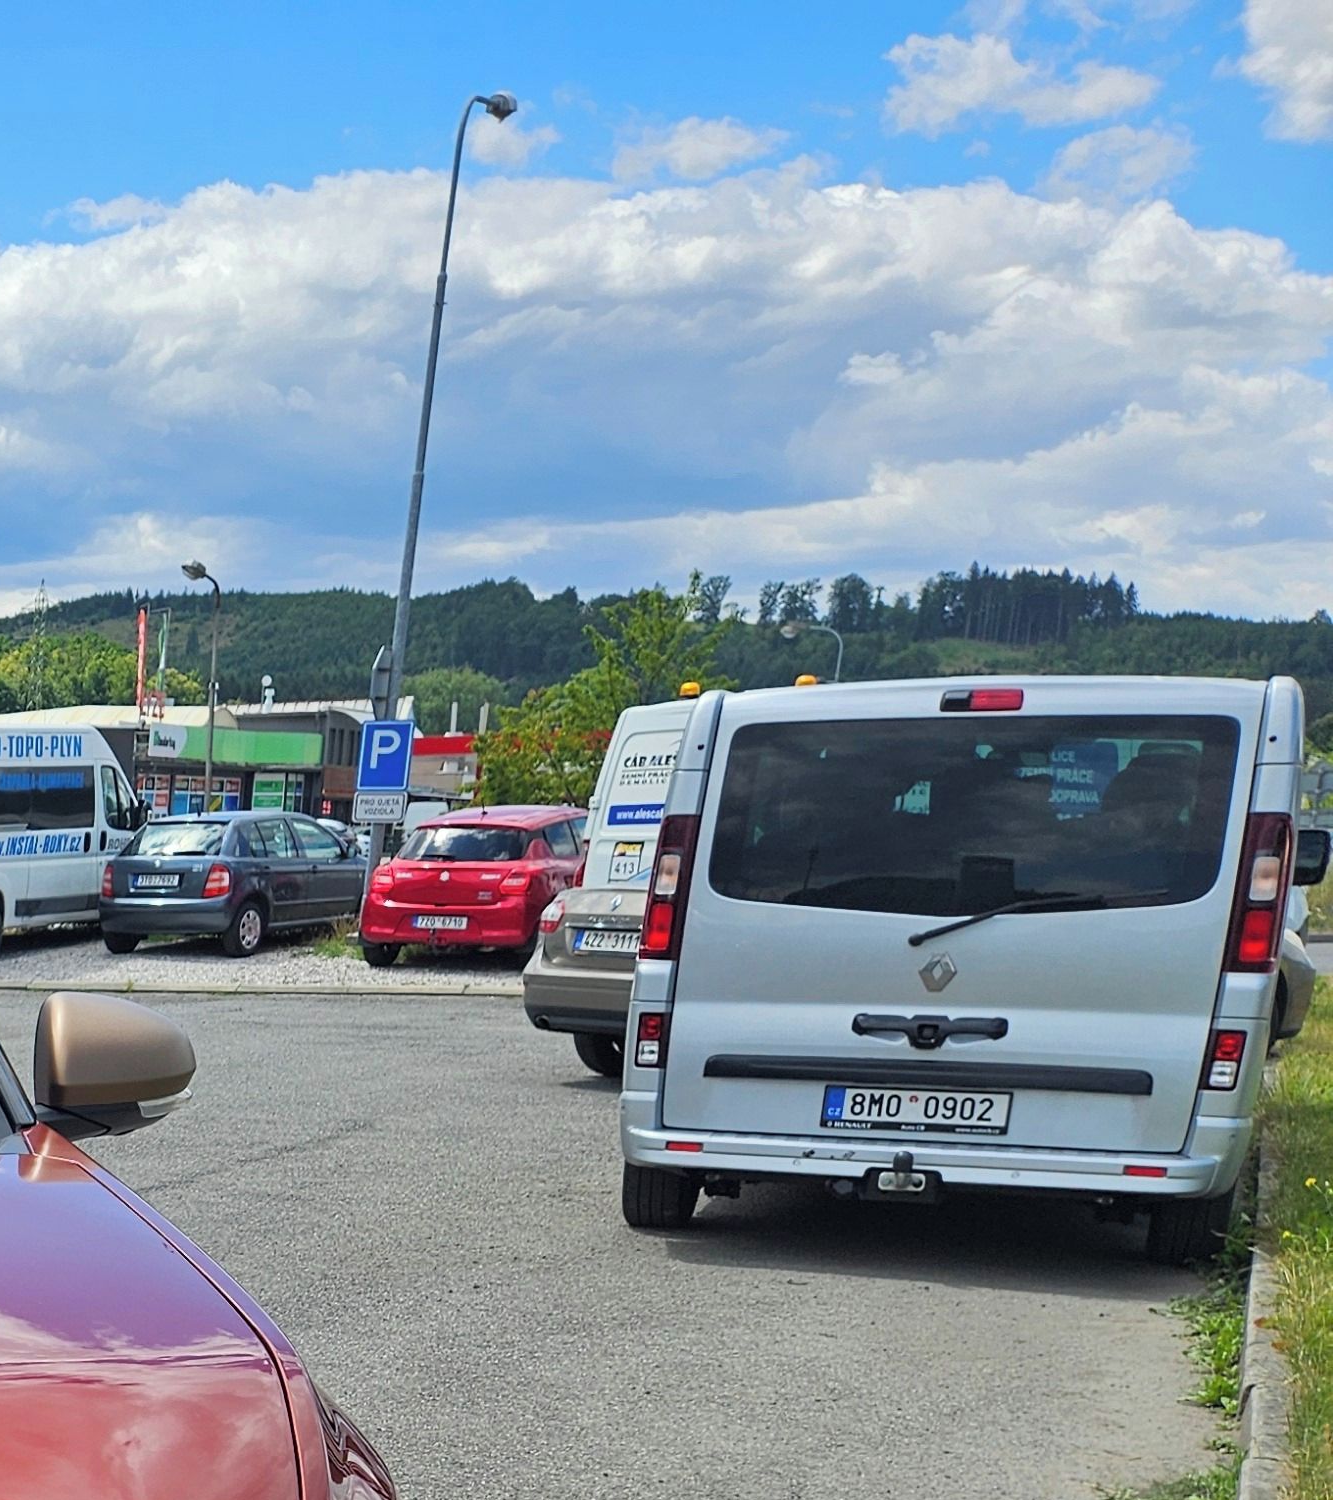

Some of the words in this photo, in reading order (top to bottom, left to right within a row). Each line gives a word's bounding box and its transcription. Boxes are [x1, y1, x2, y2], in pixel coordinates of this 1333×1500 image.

[370, 729, 401, 769] P
[923, 1096, 994, 1122] 0902
[834, 1121, 872, 1130] RENAULT
